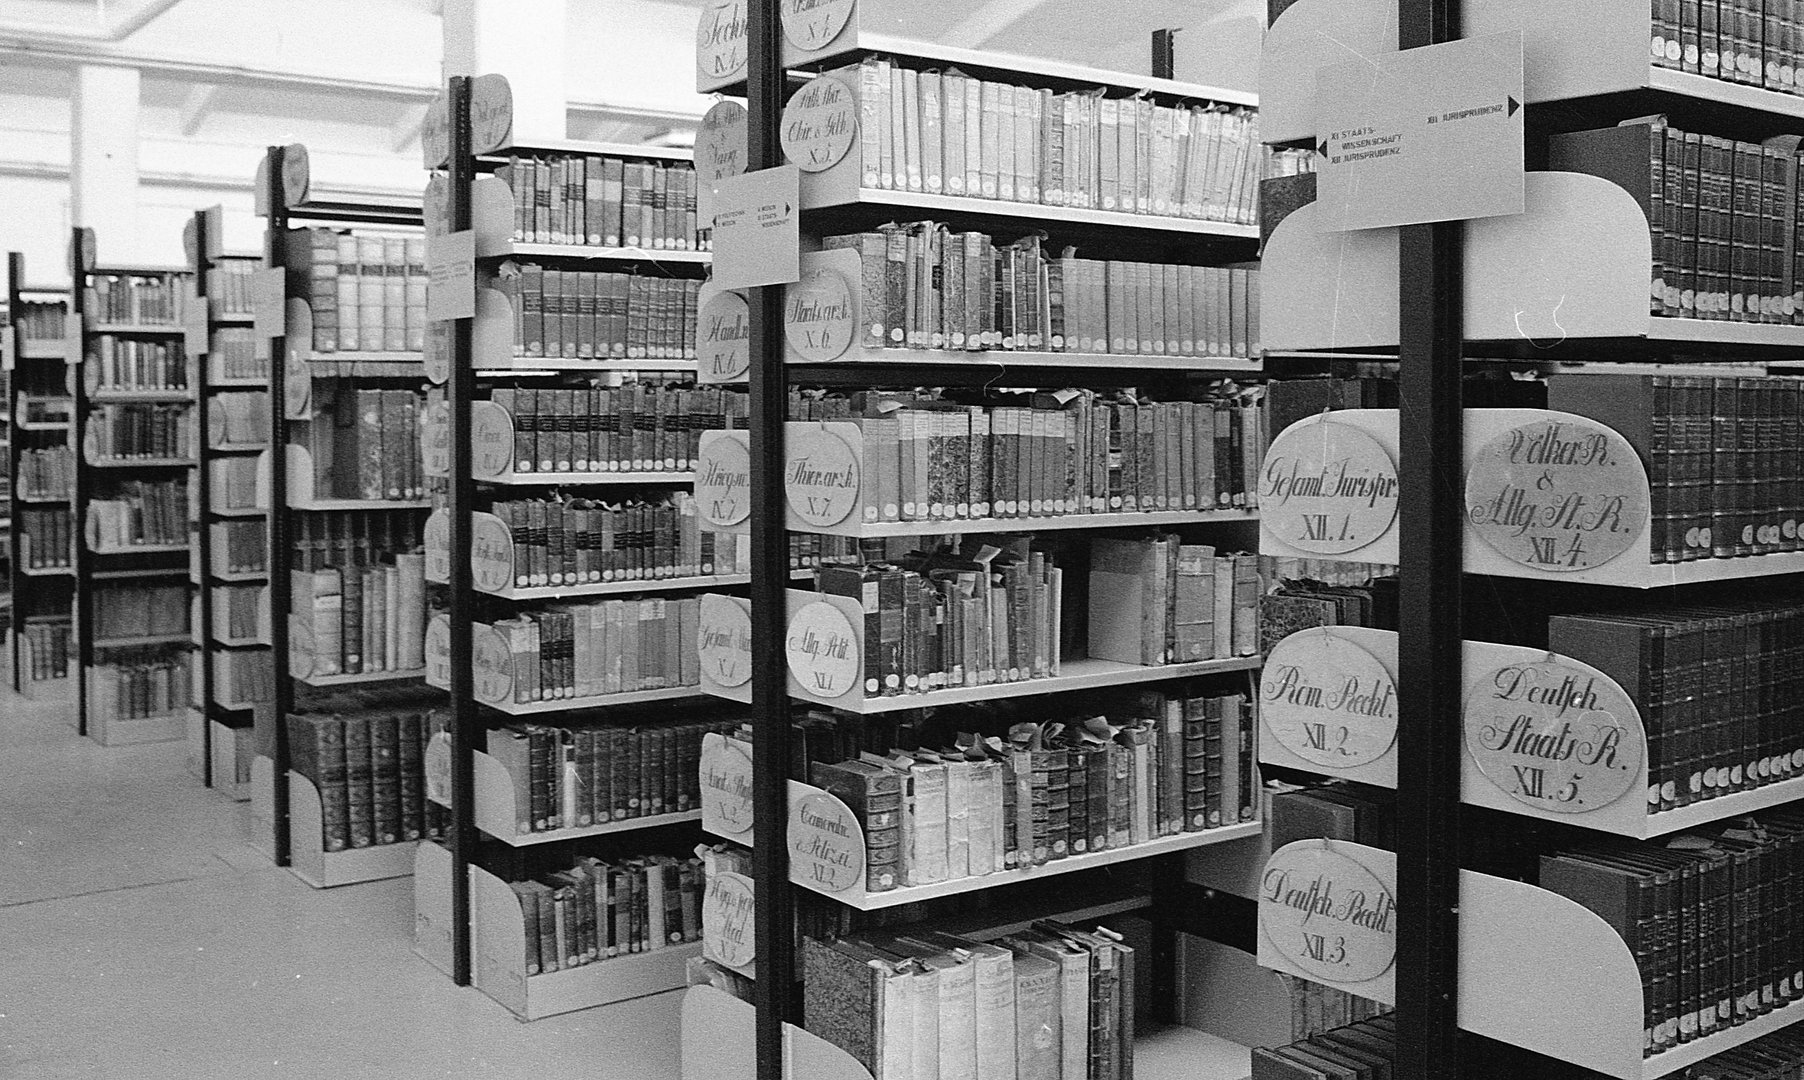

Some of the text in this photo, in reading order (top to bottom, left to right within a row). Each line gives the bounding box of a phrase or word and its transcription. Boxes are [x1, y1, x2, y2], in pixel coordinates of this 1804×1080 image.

[1342, 134, 1402, 150] WISSENSCHAFT
[1343, 147, 1401, 163] JURISPRUDENZ
[1536, 469, 1555, 491] &
[1470, 484, 1536, 538] Allg.
[1326, 674, 1396, 719] Recht.
